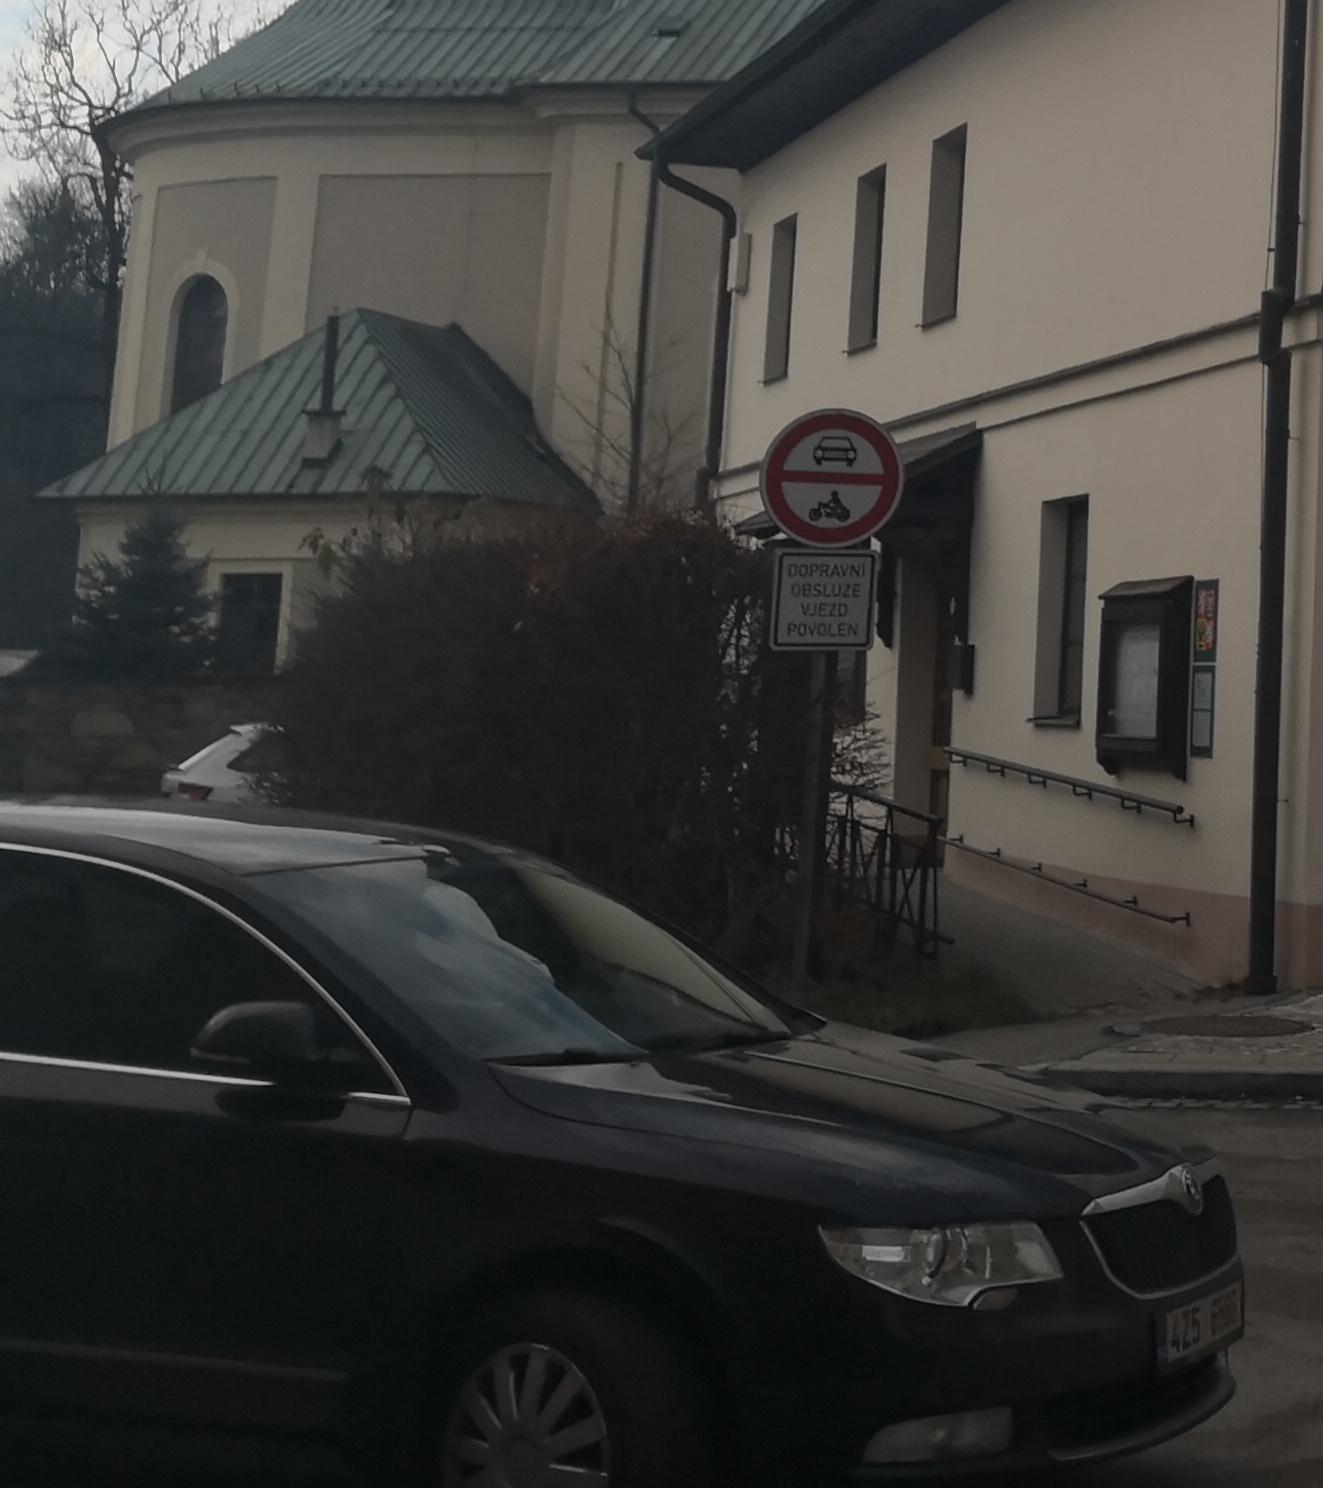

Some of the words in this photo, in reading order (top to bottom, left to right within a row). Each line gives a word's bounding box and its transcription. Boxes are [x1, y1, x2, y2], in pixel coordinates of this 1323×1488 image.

[791, 582, 862, 599] OBSLUZE
[800, 602, 849, 618] VJEZD
[787, 622, 858, 638] POVOLEN
